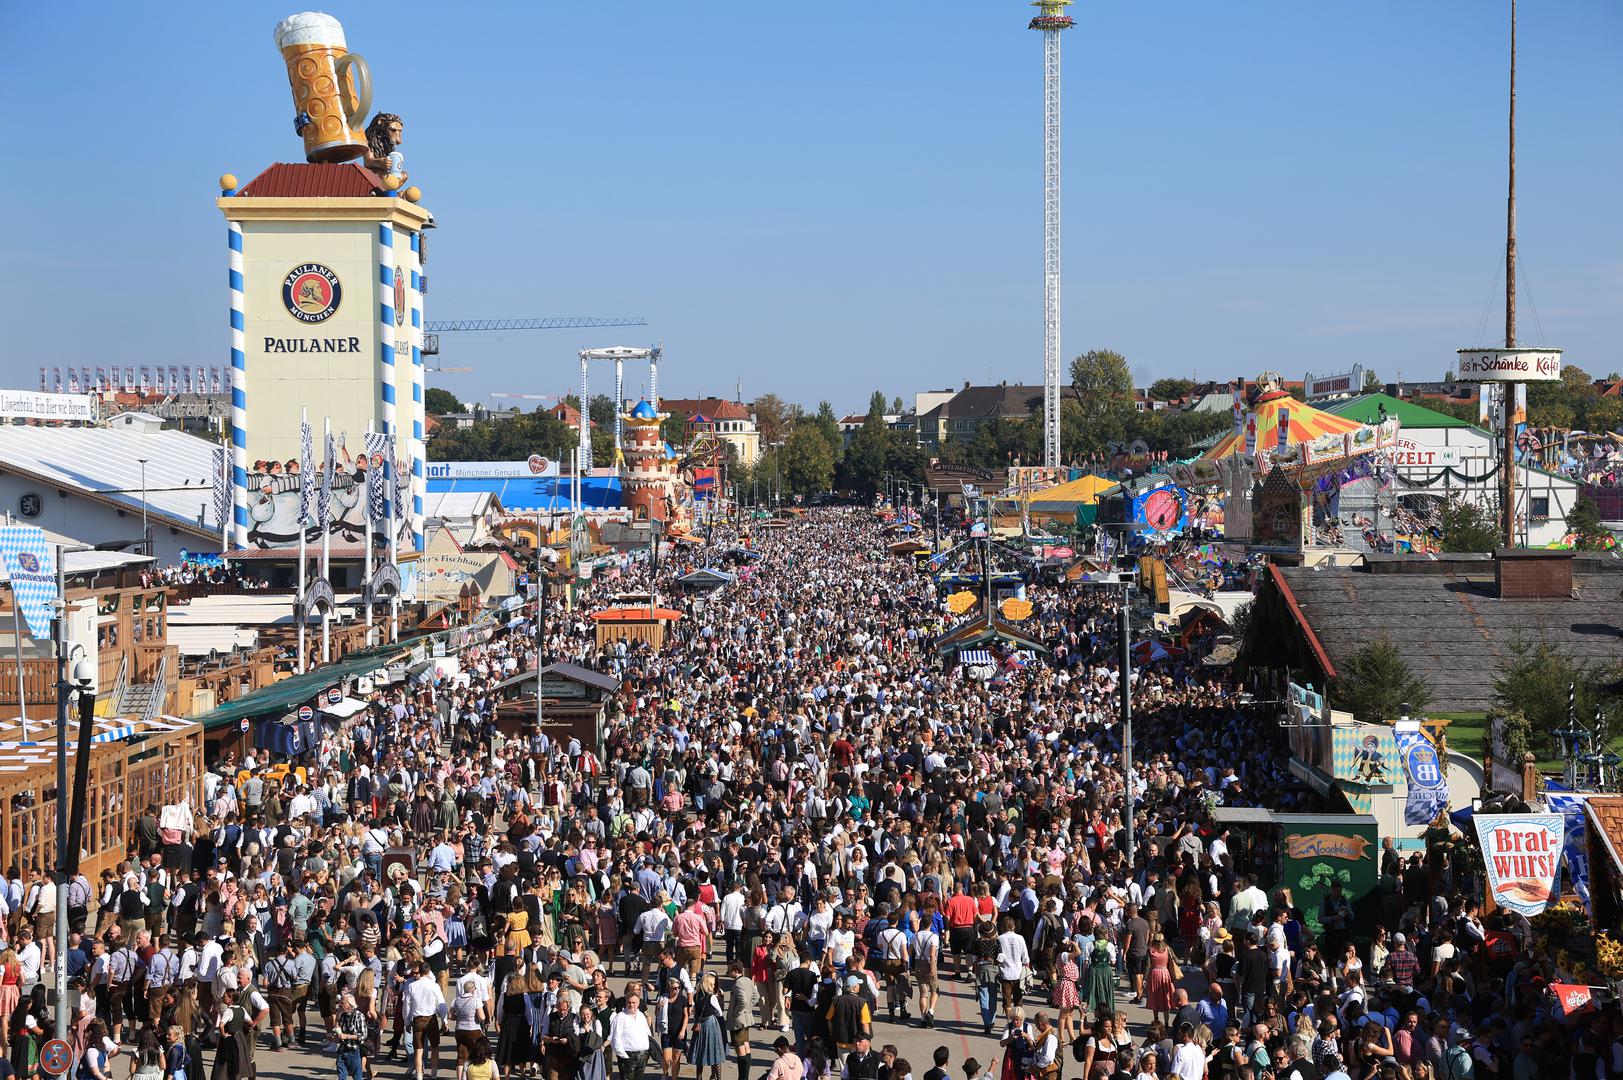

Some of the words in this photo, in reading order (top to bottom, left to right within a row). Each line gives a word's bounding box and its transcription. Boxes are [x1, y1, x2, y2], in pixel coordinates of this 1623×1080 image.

[285, 265, 338, 286] PAULANER
[290, 307, 334, 321] MÜNCHEN
[263, 337, 361, 353] PAULANER
[441, 555, 482, 568] Fischhaus
[1494, 828, 1558, 852] Brat-
[1493, 851, 1555, 878] wurst
